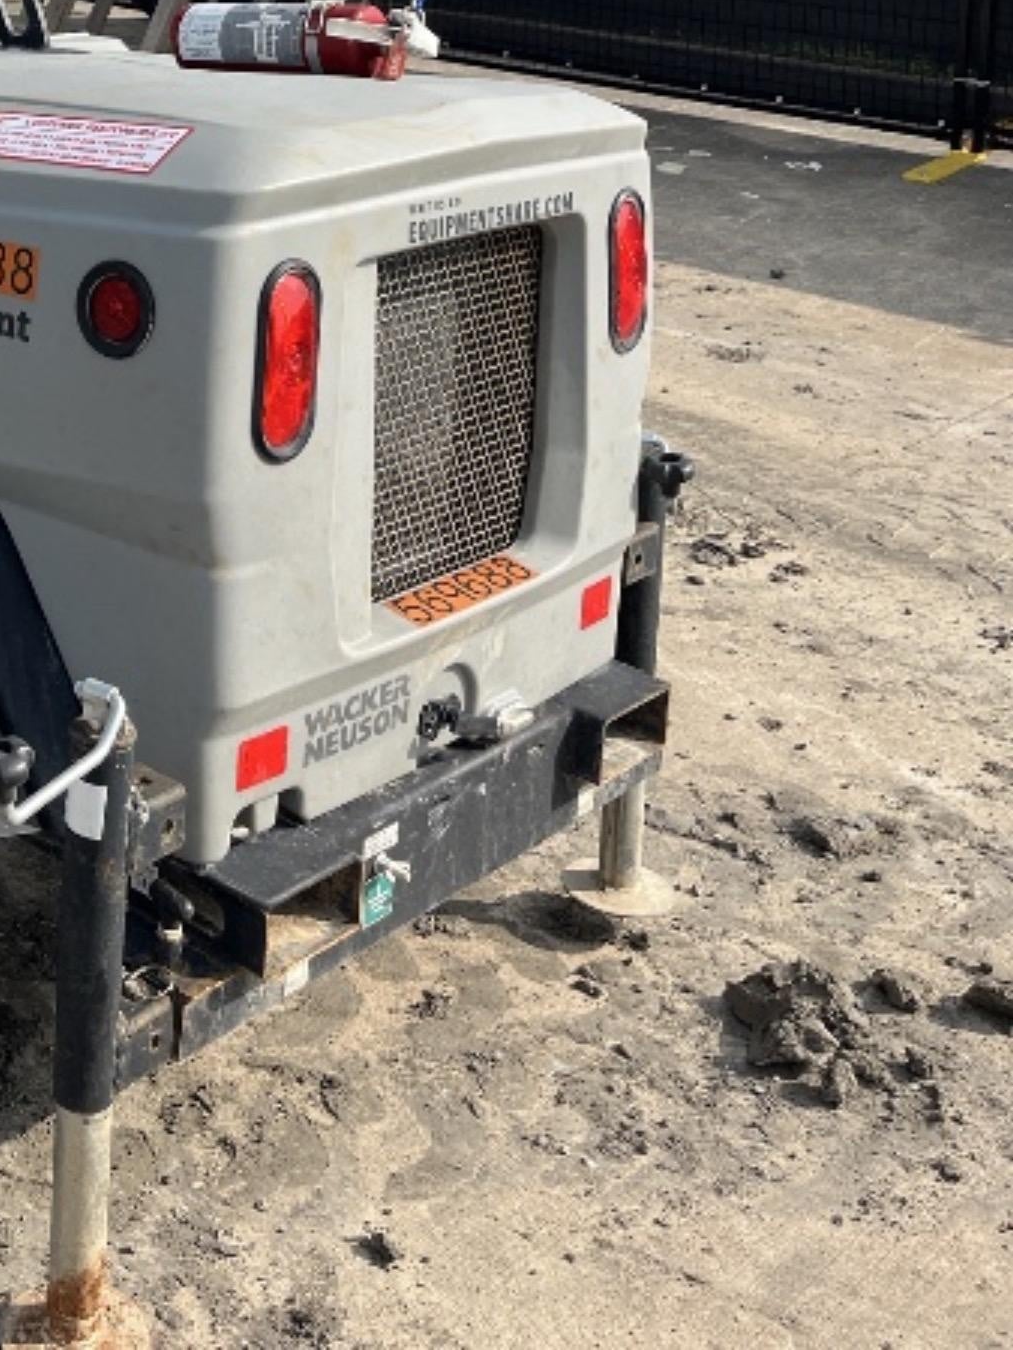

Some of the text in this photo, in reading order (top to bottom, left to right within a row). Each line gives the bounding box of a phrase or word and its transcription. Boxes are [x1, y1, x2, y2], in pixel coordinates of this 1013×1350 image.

[392, 556, 532, 625] 569688
[301, 700, 411, 768] NEUSON
[303, 674, 412, 737] WACKER
